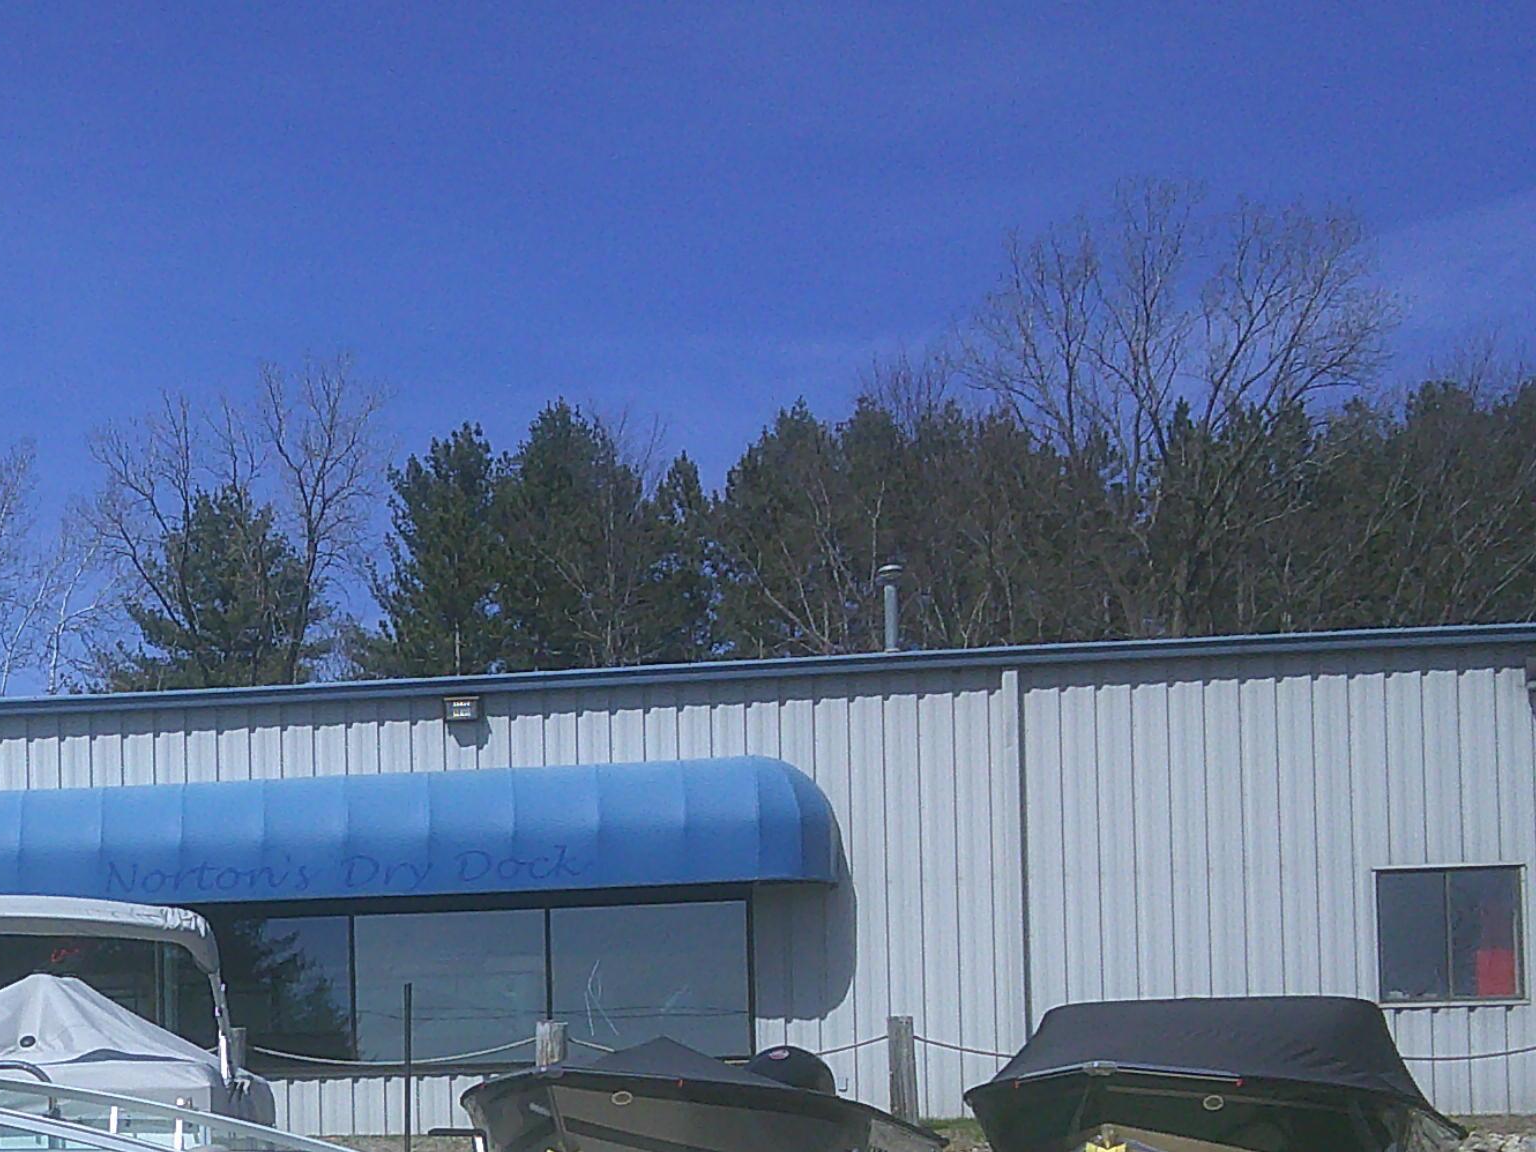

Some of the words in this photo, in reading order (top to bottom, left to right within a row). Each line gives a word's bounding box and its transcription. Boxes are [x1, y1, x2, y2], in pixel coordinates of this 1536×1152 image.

[105, 854, 311, 893] Norton's
[341, 854, 433, 890] Dry
[453, 844, 582, 882] Dock
